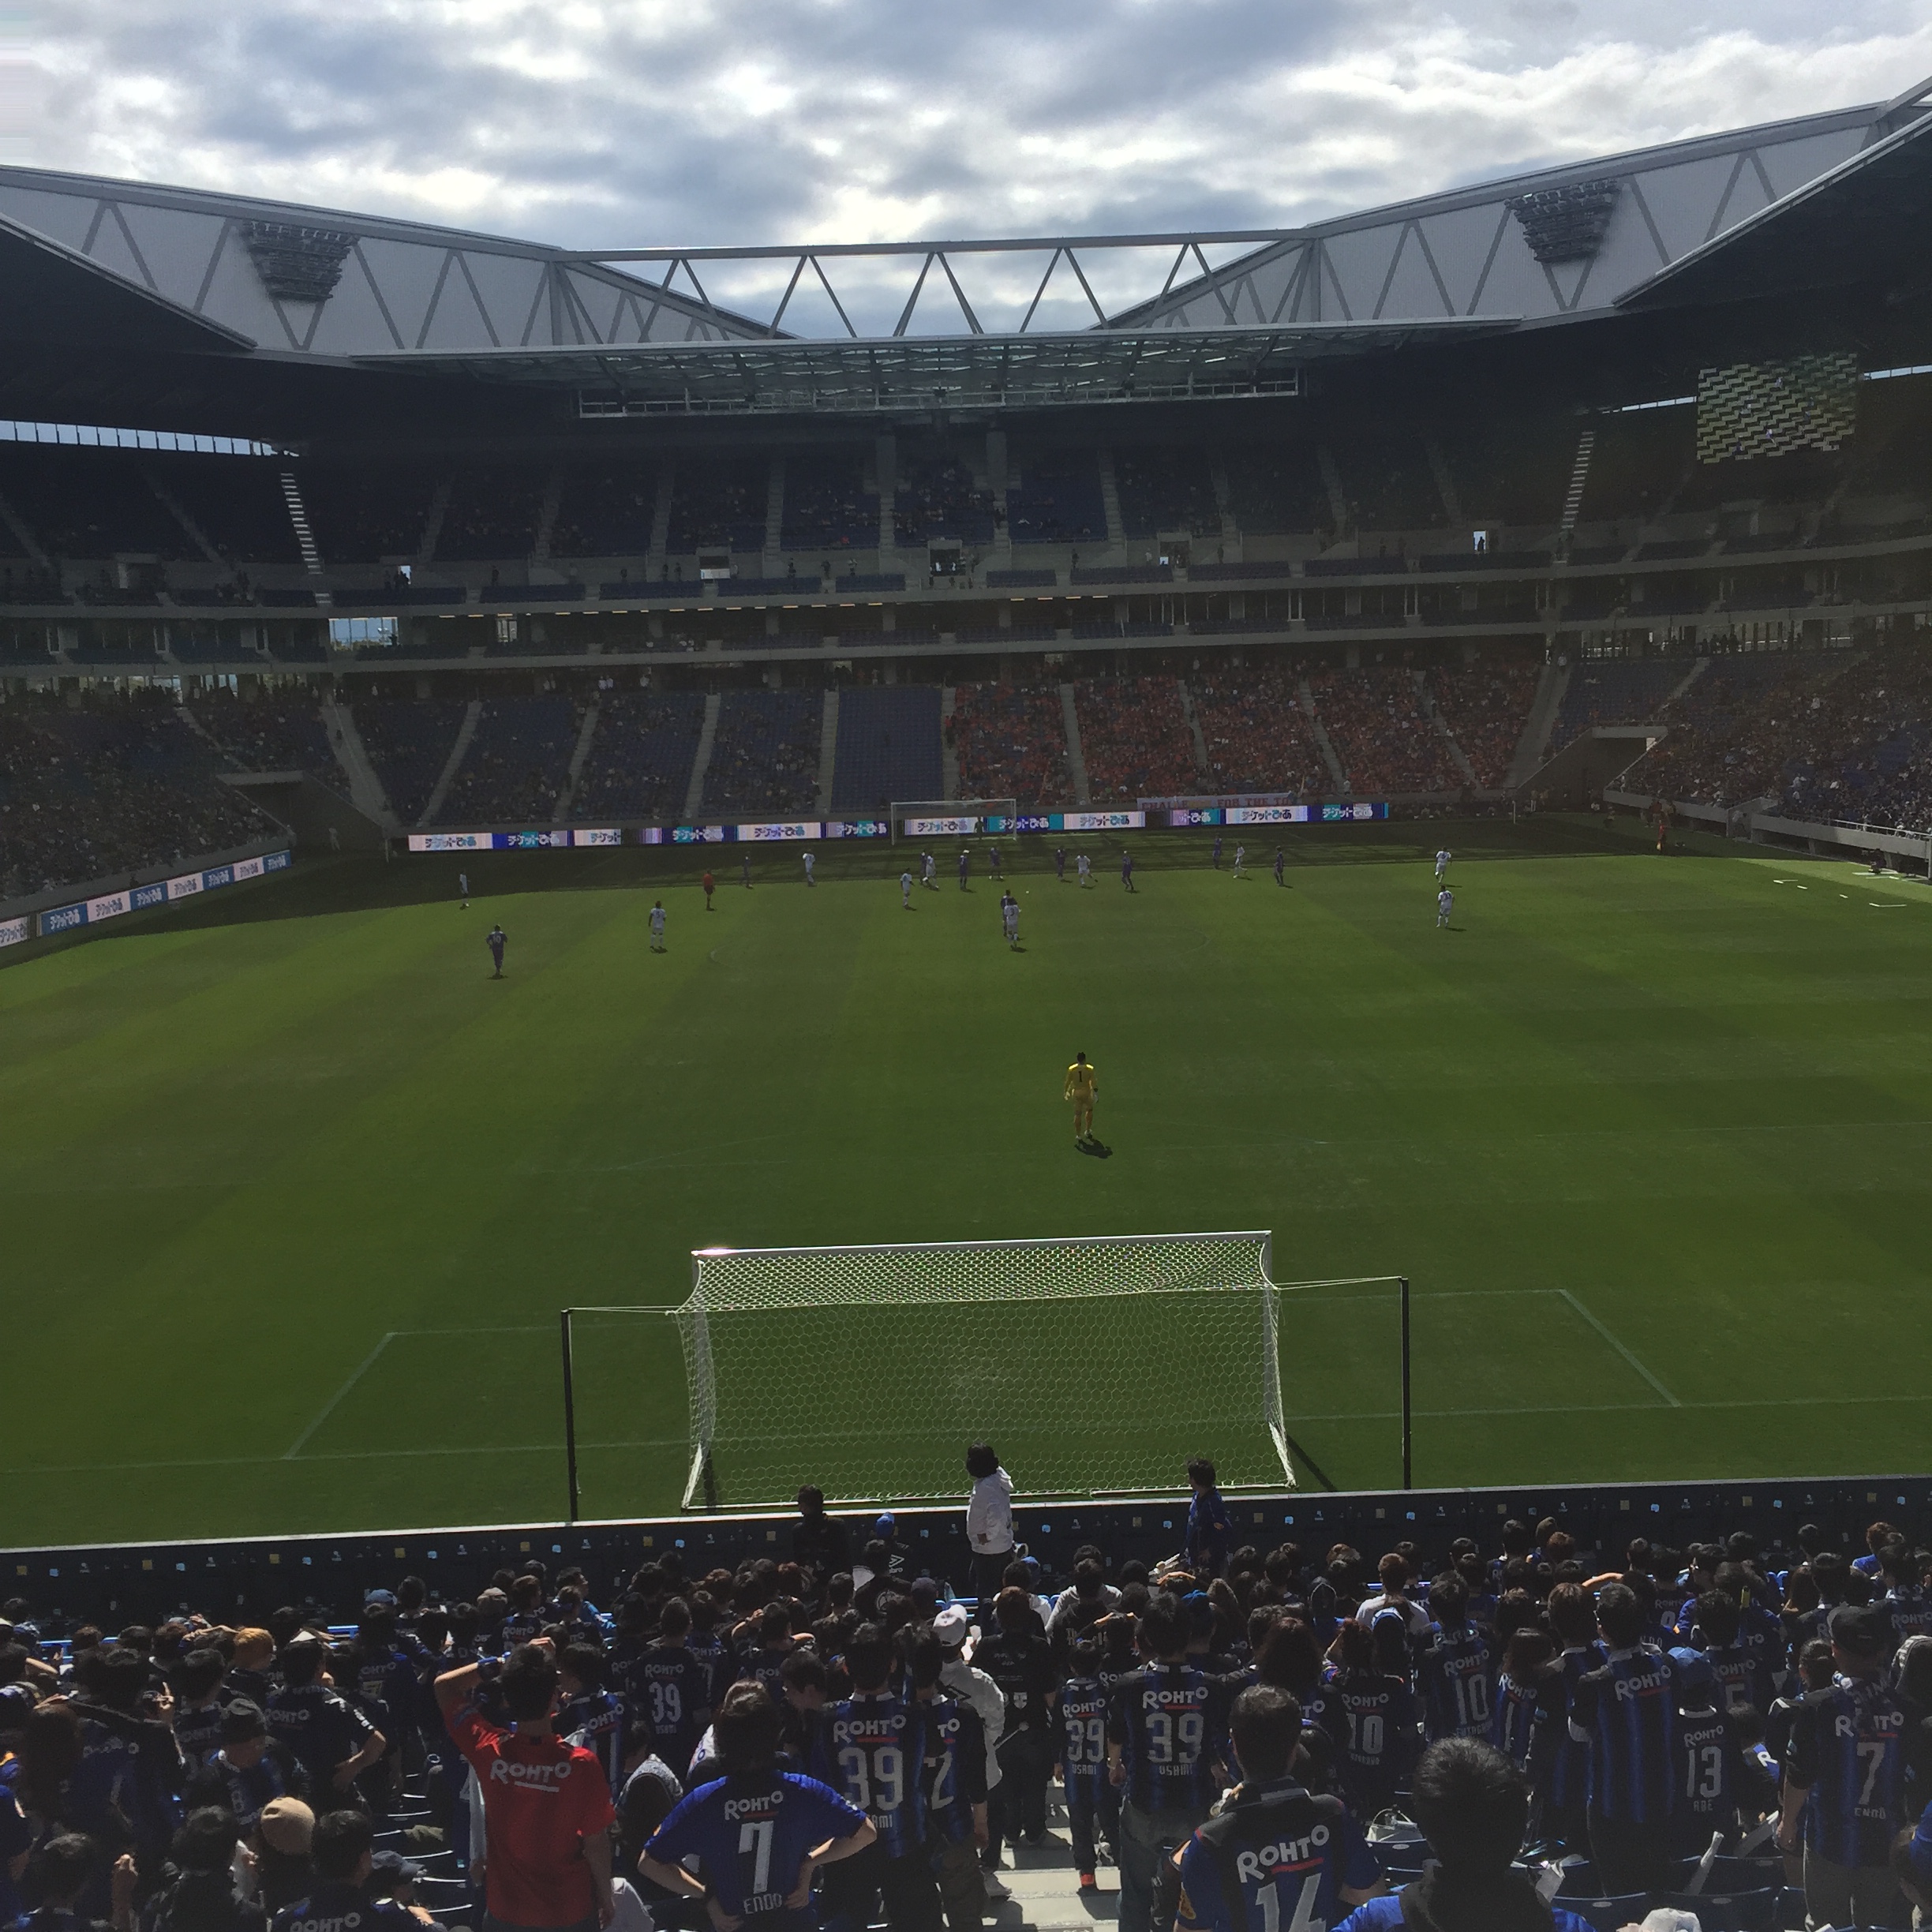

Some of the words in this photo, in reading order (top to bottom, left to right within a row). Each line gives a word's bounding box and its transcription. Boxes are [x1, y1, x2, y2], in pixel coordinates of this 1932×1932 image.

[1078, 1071, 1083, 1082] 1
[503, 1626, 534, 1640] ROHTO
[1892, 1611, 1932, 1629] ROHTO
[361, 1663, 396, 1677] OHTO
[644, 1664, 684, 1679] ROHTO
[1443, 1650, 1490, 1676] ROHTO
[1499, 1672, 1538, 1700] ROHTO
[1615, 1665, 1672, 1702] ROHTO
[649, 1682, 681, 1724] 39
[1062, 1699, 1106, 1719] ROHTO
[1142, 1687, 1209, 1711] ROHTO
[1342, 1693, 1389, 1711] ROHTO
[1455, 1673, 1487, 1727] 10
[833, 1713, 907, 1743] ROHTO
[1065, 1719, 1105, 1763] 39
[1144, 1712, 1204, 1764] 39
[1683, 1724, 1724, 1749] ROHTO
[489, 1758, 571, 1785] ROHTO
[837, 1745, 904, 1812] 39
[1686, 1746, 1722, 1799] 13
[1856, 1743, 1885, 1806] 7
[724, 1790, 784, 1822] ROHTO
[1693, 1799, 1713, 1813] ABE
[738, 1819, 774, 1896] 7
[1236, 1824, 1331, 1884] ROHTO
[743, 1893, 784, 1915] ENDO
[1254, 1871, 1327, 1932] 14
